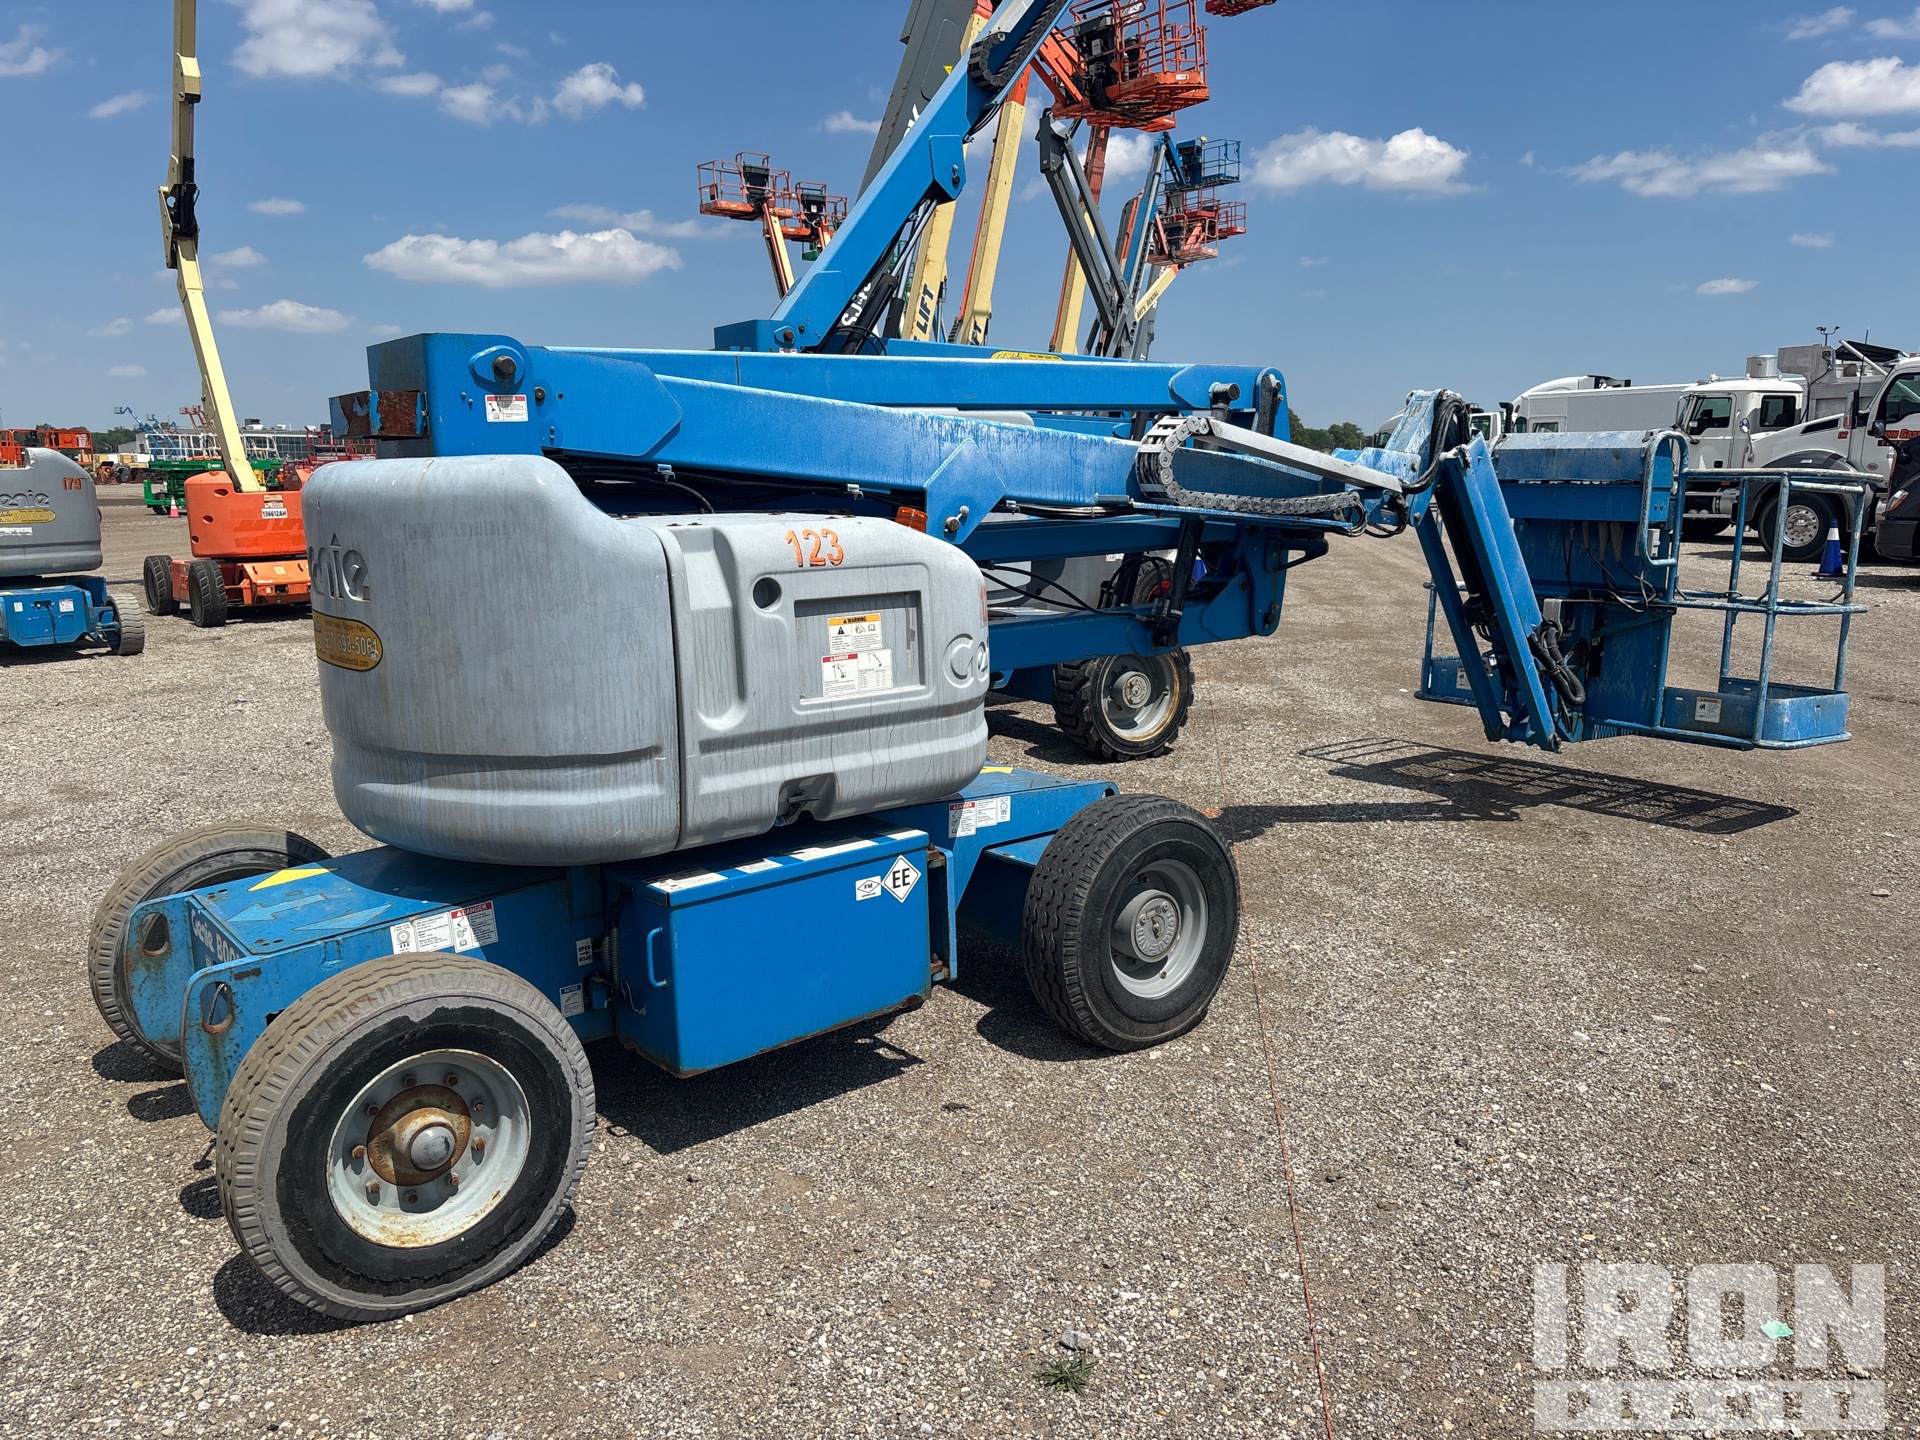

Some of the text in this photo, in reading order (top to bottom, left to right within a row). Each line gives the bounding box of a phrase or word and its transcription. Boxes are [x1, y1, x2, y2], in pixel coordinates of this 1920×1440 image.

[916, 283, 935, 336] LIFT
[785, 528, 844, 568] 123
[848, 616, 867, 624] WARNING
[892, 867, 911, 889] EE
[462, 903, 487, 916] DANGER
